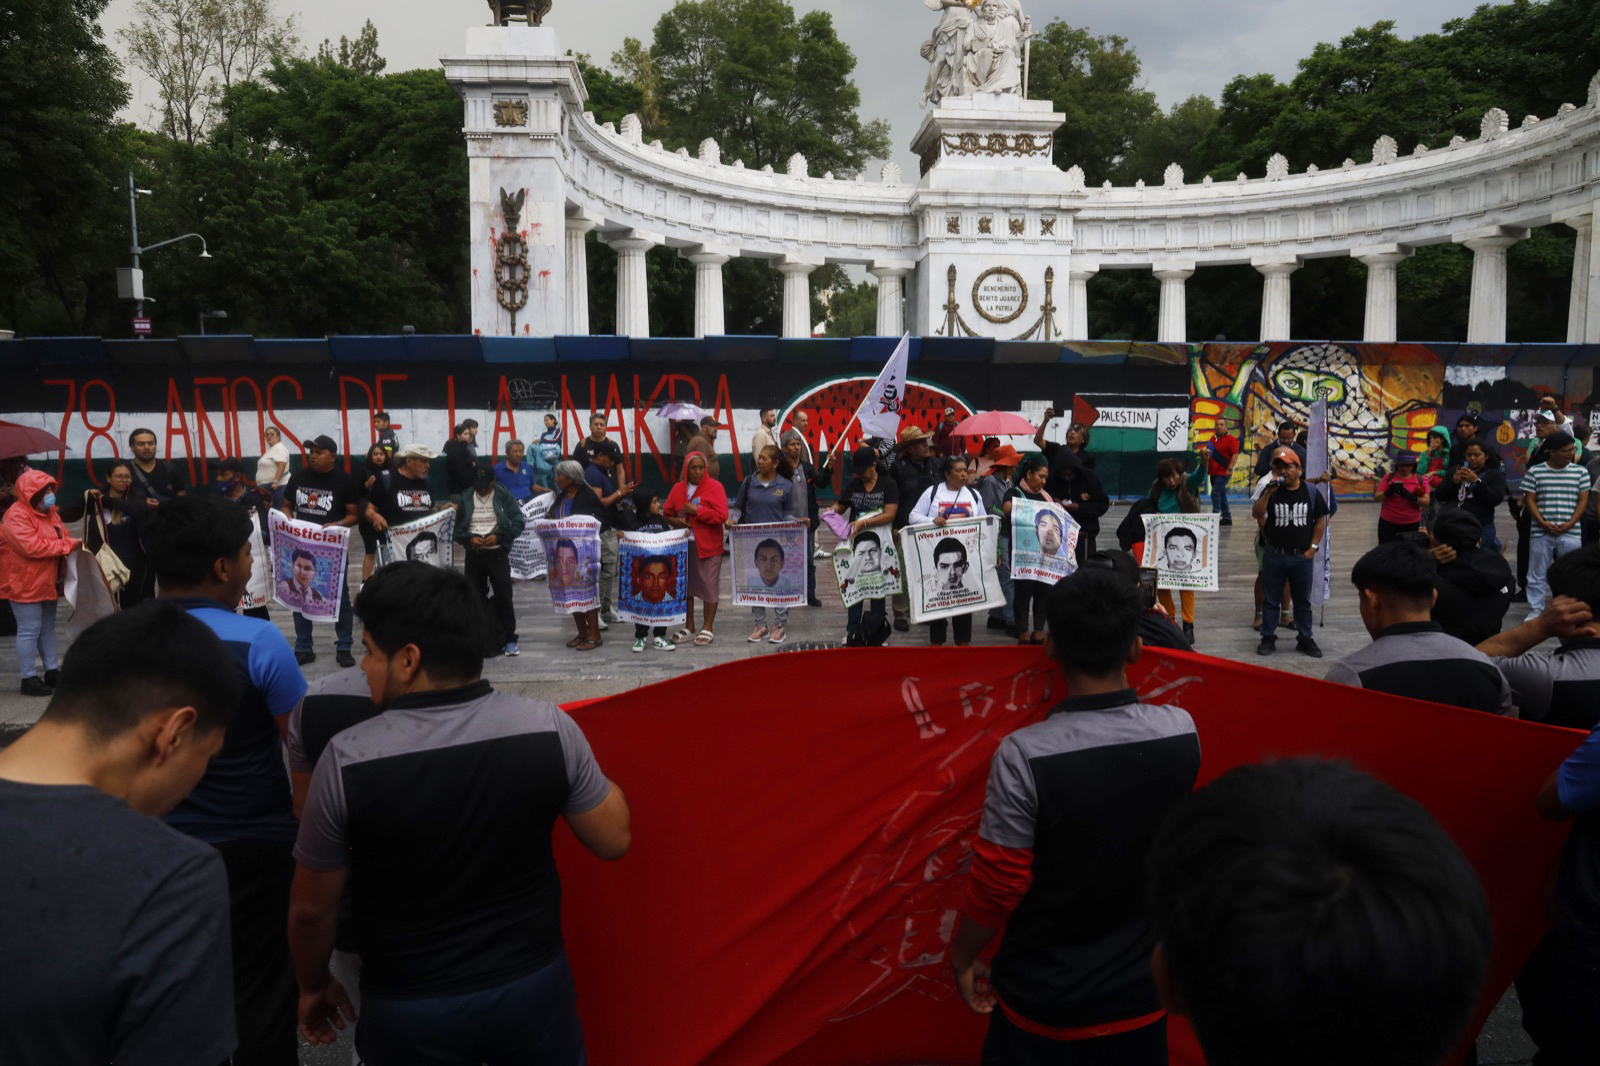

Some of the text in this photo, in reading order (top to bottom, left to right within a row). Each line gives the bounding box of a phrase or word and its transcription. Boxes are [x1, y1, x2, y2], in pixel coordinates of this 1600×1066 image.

[1101, 410, 1152, 424] PALESTINA
[44, 379, 119, 487] 78
[1158, 413, 1186, 447] LIBRE
[566, 521, 596, 529] llevaron!
[275, 521, 343, 544] ¡Justicia!
[917, 532, 934, 541] ¡Vivo
[942, 528, 949, 536] lo
[949, 526, 978, 535] llevaron!
[1018, 567, 1032, 576] ¡Vivo
[740, 594, 757, 602] ¡Vivo
[766, 595, 800, 604] queremos!
